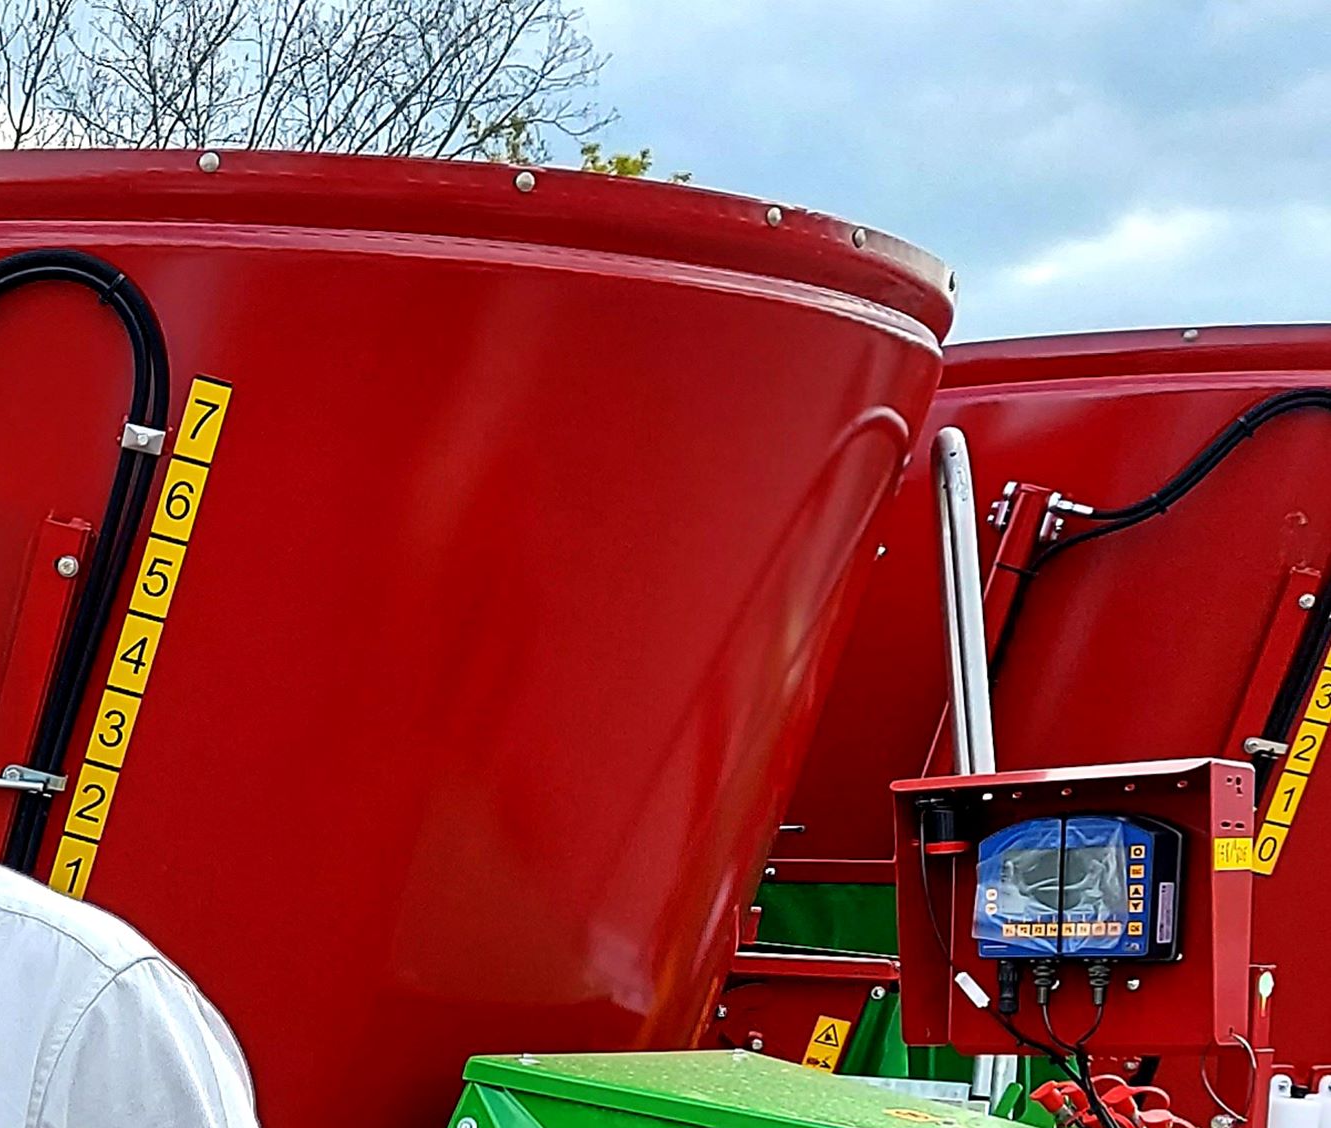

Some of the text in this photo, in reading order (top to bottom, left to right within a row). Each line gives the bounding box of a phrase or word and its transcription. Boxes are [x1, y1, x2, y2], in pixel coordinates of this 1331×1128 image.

[190, 399, 220, 440] 7
[165, 481, 194, 520] 6
[142, 557, 173, 597] 5
[120, 637, 148, 675] 4
[1315, 683, 1331, 710] 3
[98, 710, 126, 748] 3
[1293, 735, 1317, 762] 2
[75, 784, 106, 823] 2
[1284, 787, 1296, 812] 1
[1258, 836, 1277, 862] 0
[65, 858, 83, 893] 1
